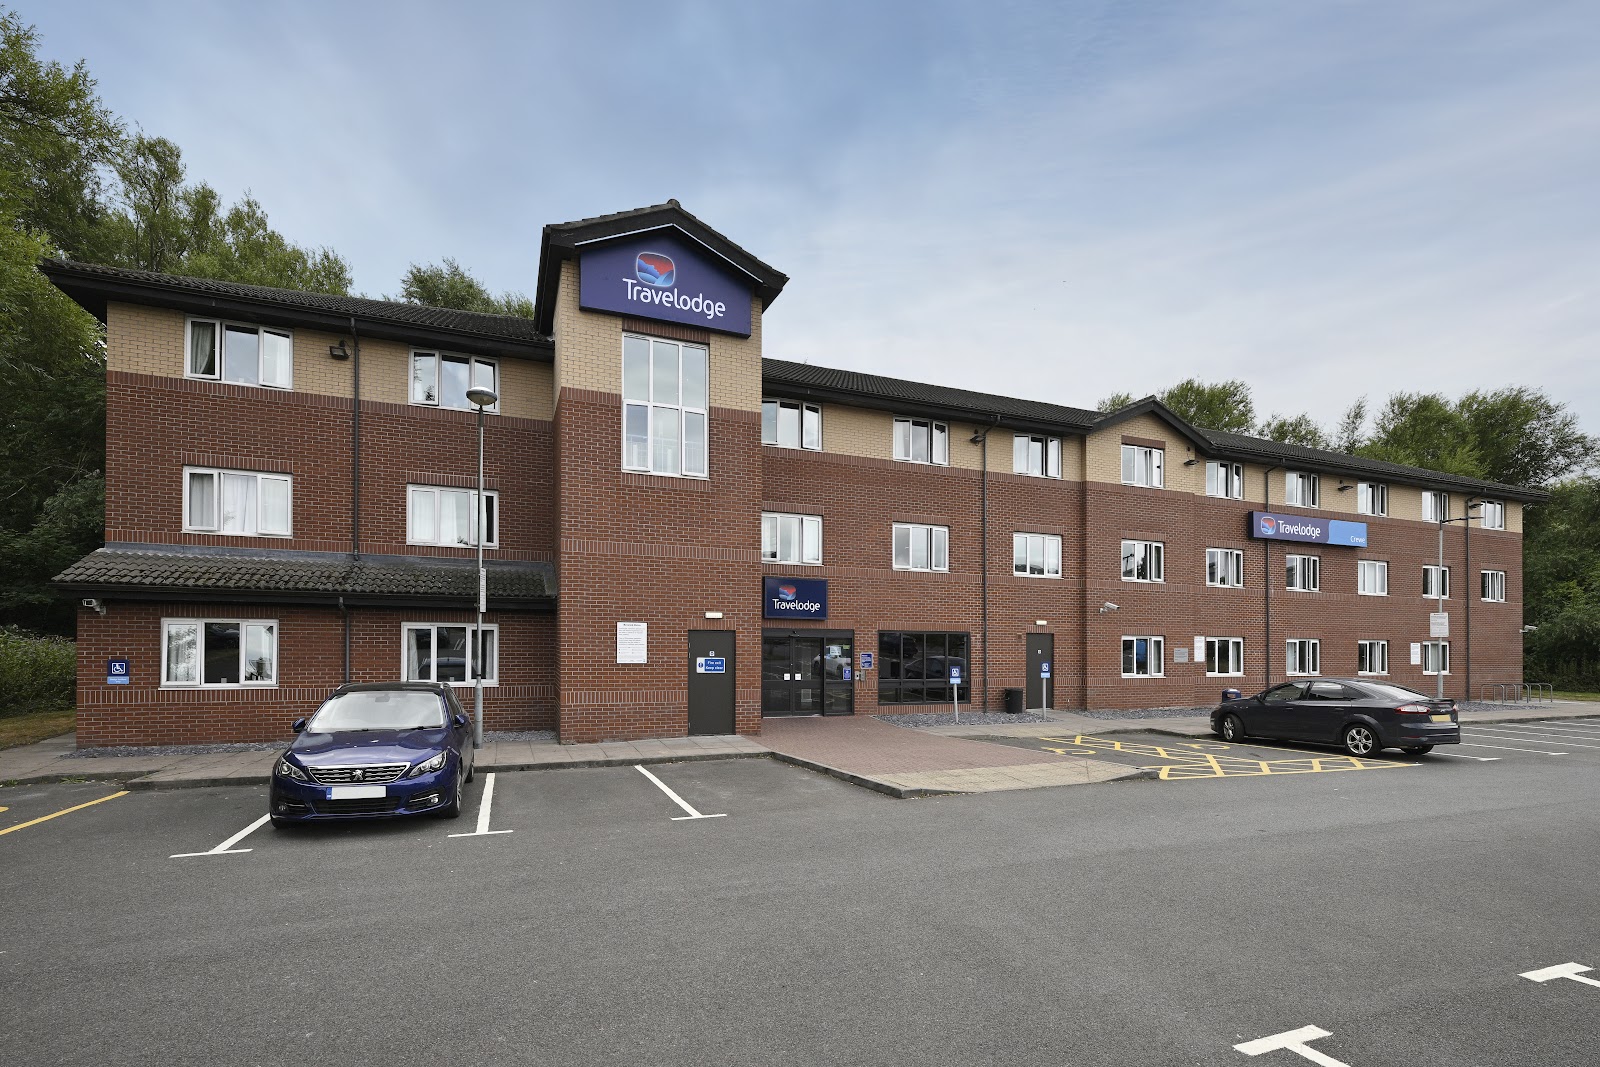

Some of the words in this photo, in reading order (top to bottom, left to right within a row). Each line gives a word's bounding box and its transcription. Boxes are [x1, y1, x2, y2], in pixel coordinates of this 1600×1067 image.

[622, 278, 726, 319] Travelodge
[1278, 520, 1321, 539] Travelodge
[772, 598, 821, 613] Travelodge
